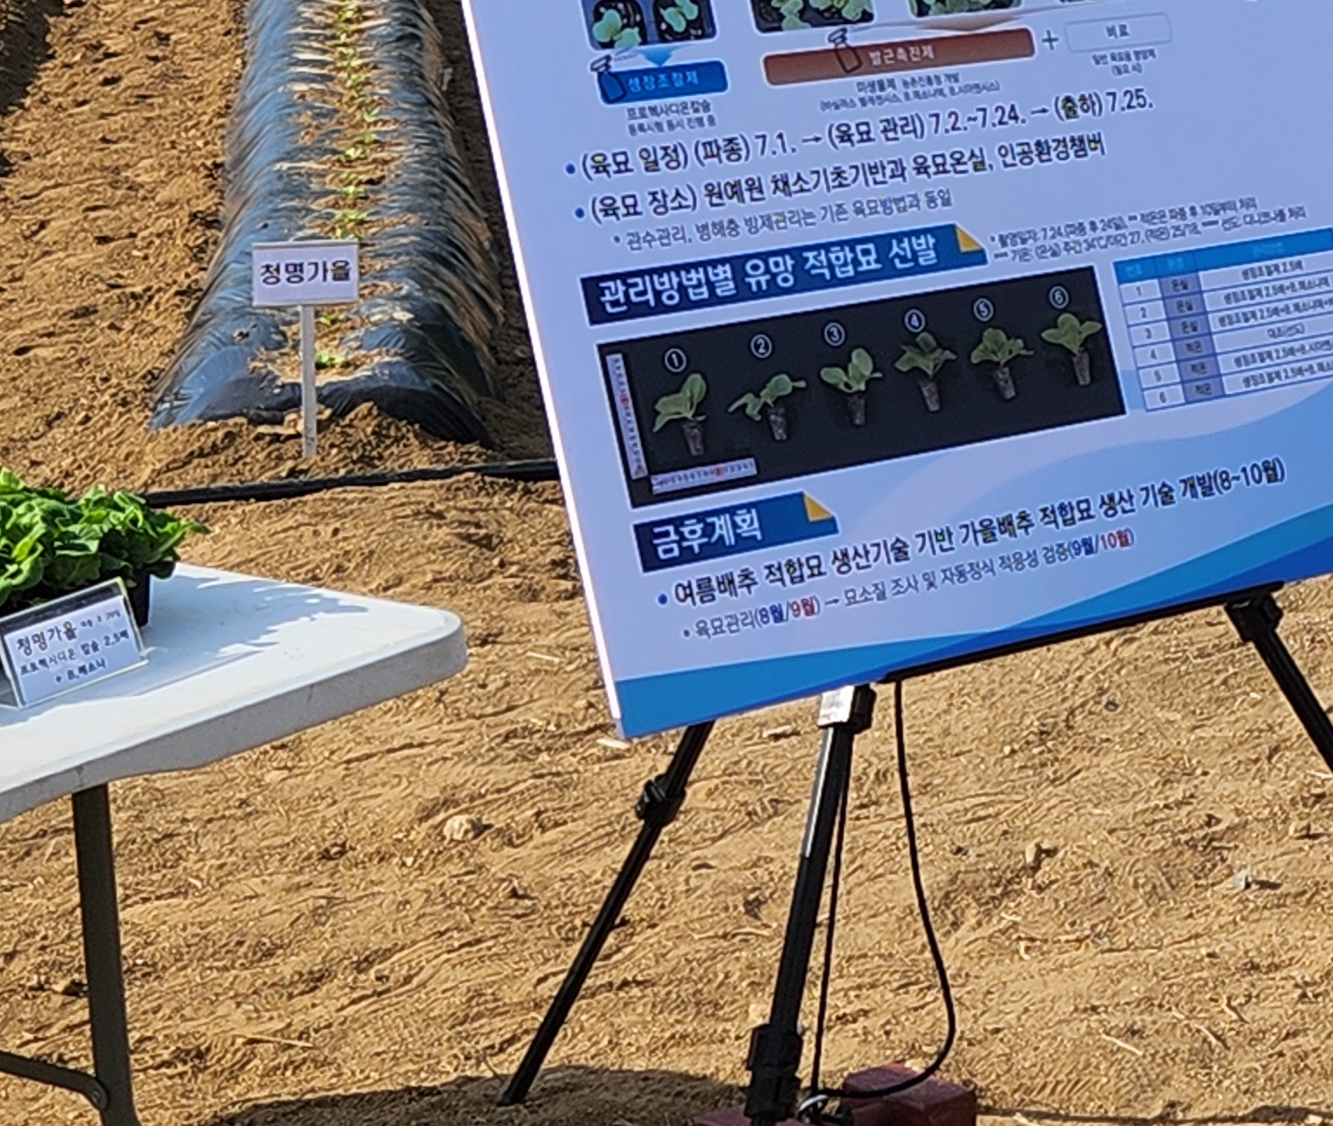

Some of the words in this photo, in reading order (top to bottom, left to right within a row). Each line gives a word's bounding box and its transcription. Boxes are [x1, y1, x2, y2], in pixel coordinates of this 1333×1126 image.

[582, 151, 633, 181] (육묘
[640, 143, 688, 173] 일정)
[695, 133, 749, 166] (파종)
[755, 132, 796, 156] 7.1.
[828, 123, 875, 151] (육묘
[881, 113, 925, 141] 관리)
[1055, 93, 1103, 121] (출하)
[1108, 88, 1153, 112] 7.25.
[591, 193, 642, 224] (육묘
[648, 184, 697, 217] 장소)
[704, 177, 764, 208] 원예원
[771, 158, 907, 196] 채소기초기반과
[912, 146, 993, 176] 육묘온실,
[260, 260, 351, 285] 청명가을
[600, 264, 737, 313] 관리방법별
[745, 251, 796, 293] 유망
[803, 242, 882, 281] 적합묘
[887, 232, 936, 268] 선발
[651, 508, 763, 560] 금후계획
[675, 569, 756, 607] 여름배추
[764, 554, 827, 585] 적합묘
[831, 538, 909, 573] 생산기술
[915, 526, 956, 556] 기반
[960, 510, 1036, 548] 가을배추
[1039, 498, 1095, 531] 적합묘
[1099, 490, 1136, 518] 생산
[1140, 482, 1176, 509] 기술
[1179, 457, 1286, 501] 개발(8~10월)
[941, 559, 996, 587] 자동정식
